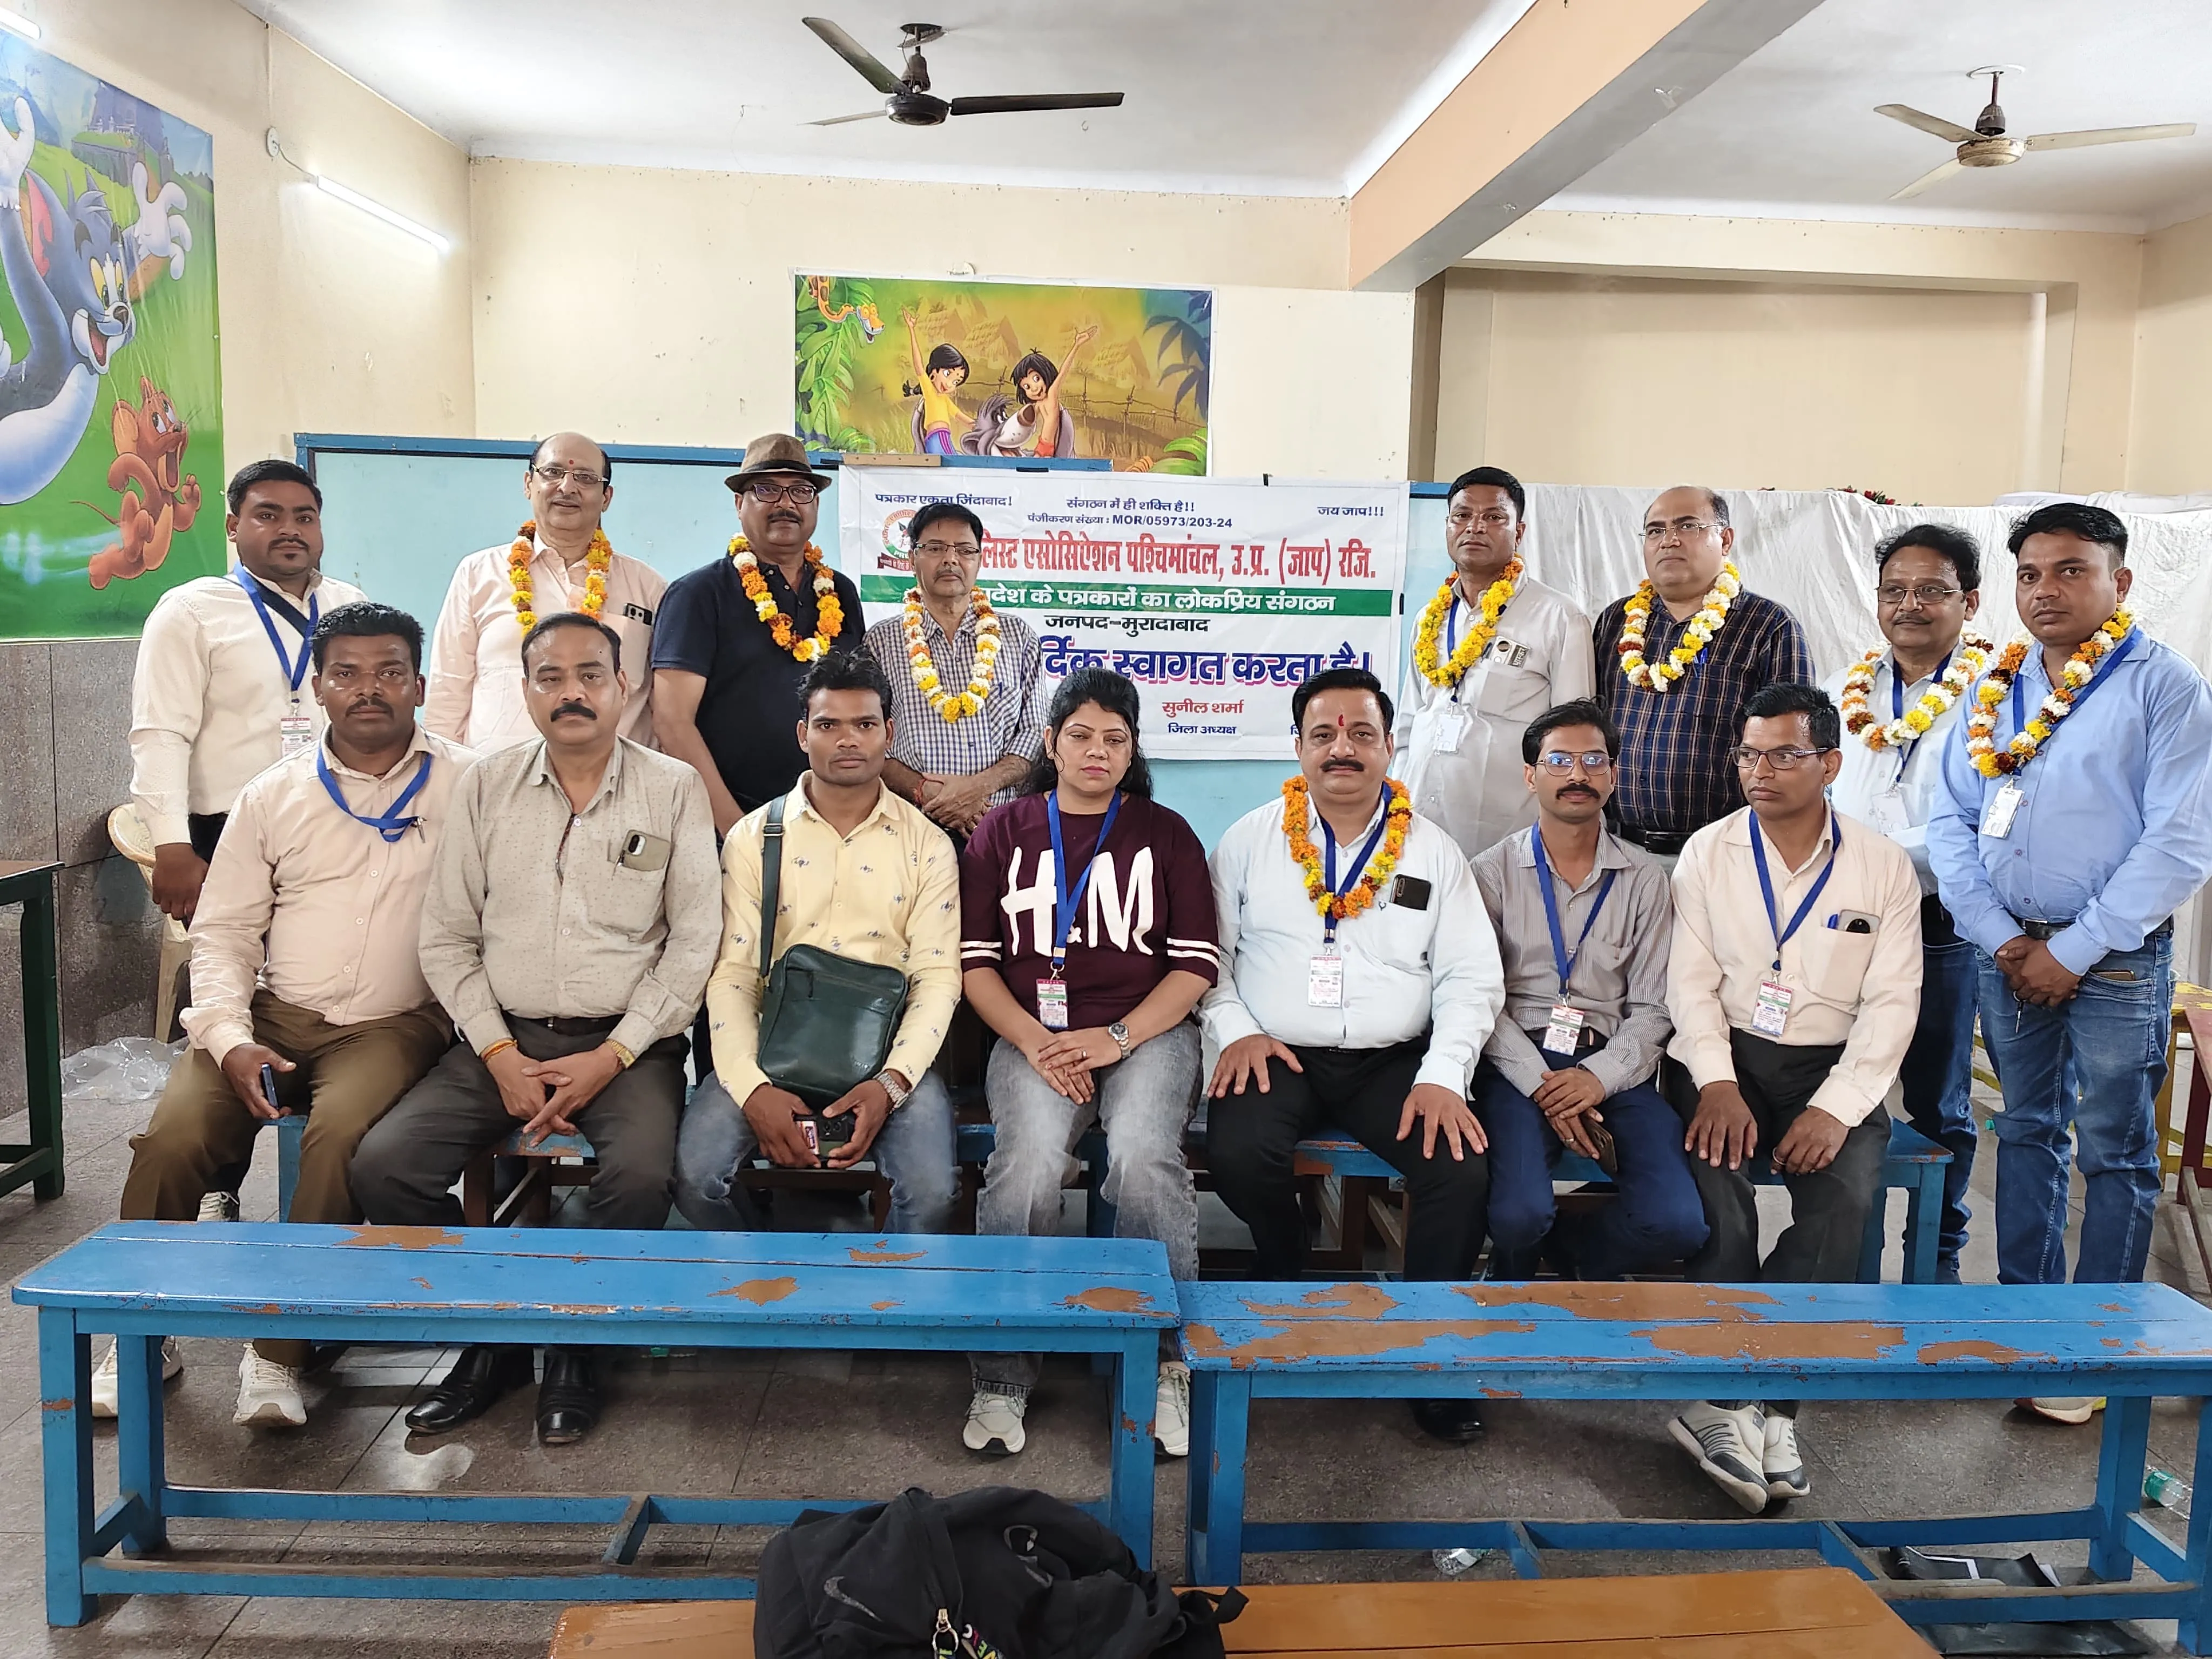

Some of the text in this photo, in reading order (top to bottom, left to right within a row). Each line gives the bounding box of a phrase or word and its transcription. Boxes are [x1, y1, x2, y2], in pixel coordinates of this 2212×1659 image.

[875, 493, 1012, 506] पत्रकार एकता जिंदाबाद!
[1067, 496, 1195, 512] संगठन में ही शक्ति है!!
[1027, 512, 1074, 524] पंजीकरण
[1075, 514, 1104, 524] संख्या
[1112, 514, 1233, 528] MOR/05973/203-24
[1317, 505, 1384, 517] जय जाप!!!
[980, 529, 1019, 569] लिस्ट
[1126, 532, 1224, 583] पश्चिमांचल,
[1230, 544, 1269, 577] उ.प्र.
[1278, 537, 1331, 585] (जाप)
[1338, 538, 1375, 578] रजि.
[1030, 584, 1054, 604] के
[1057, 586, 1137, 607] पत्रकारों
[1140, 592, 1172, 608] का
[1174, 588, 1263, 612] लोकप्रिय
[1265, 589, 1337, 611] संगठन
[1112, 649, 1228, 685] स्वागत
[1231, 652, 1326, 686] करता
[1162, 698, 1244, 718] सुनील शर्मा
[1168, 722, 1237, 735] जिला अध्यक्ष
[1000, 846, 1154, 957] H&M
